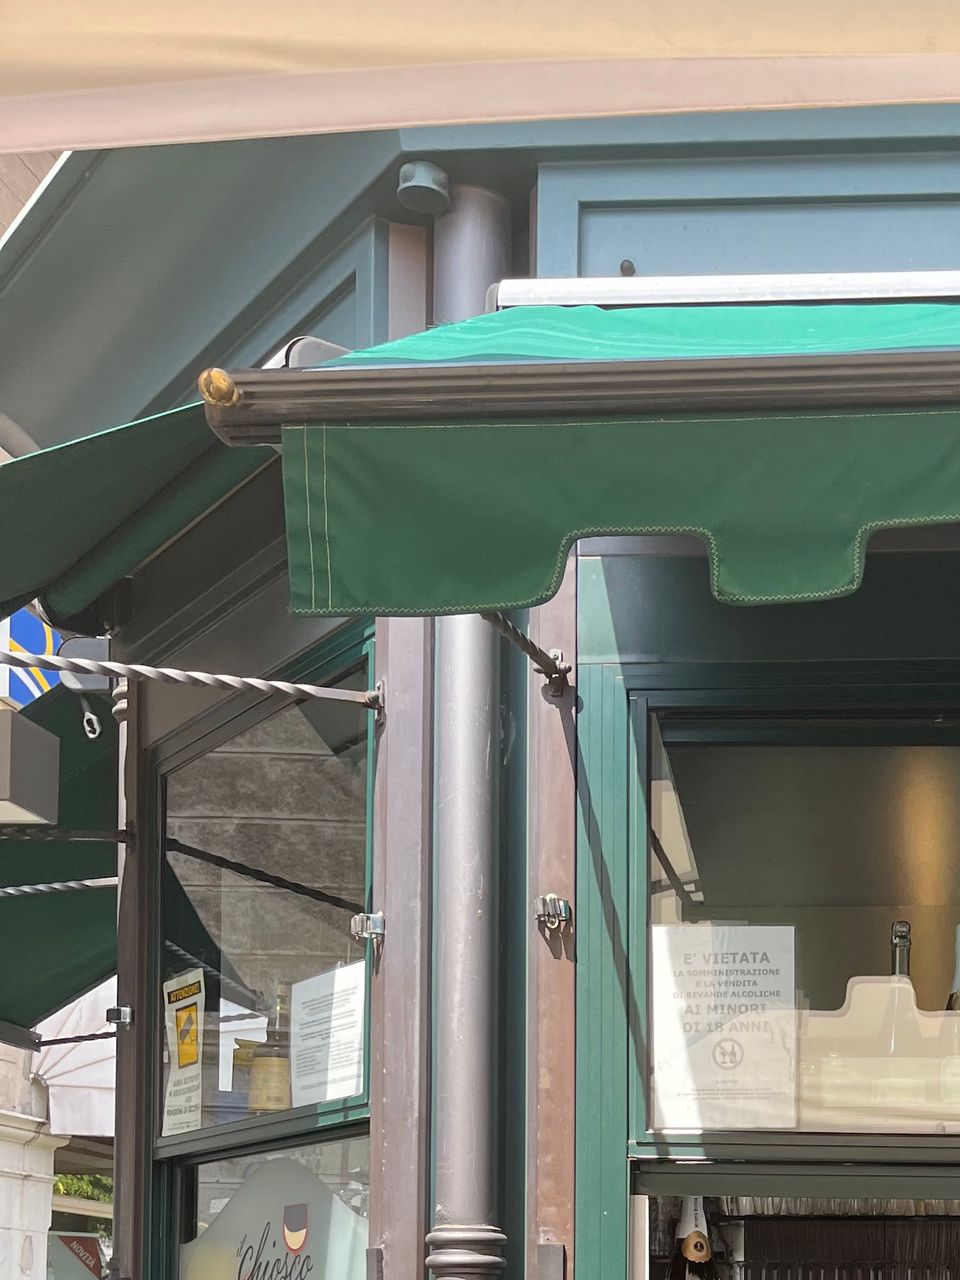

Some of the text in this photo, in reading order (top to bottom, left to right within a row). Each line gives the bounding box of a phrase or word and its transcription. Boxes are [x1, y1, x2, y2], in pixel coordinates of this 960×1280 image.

[702, 952, 770, 965] VIETATA
[686, 968, 781, 977] SOMMINISTRAZIONE
[730, 990, 781, 998] ALCOLICHE
[684, 1003, 768, 1016] AI MINORI
[683, 1020, 769, 1033] DI 18 ANNI
